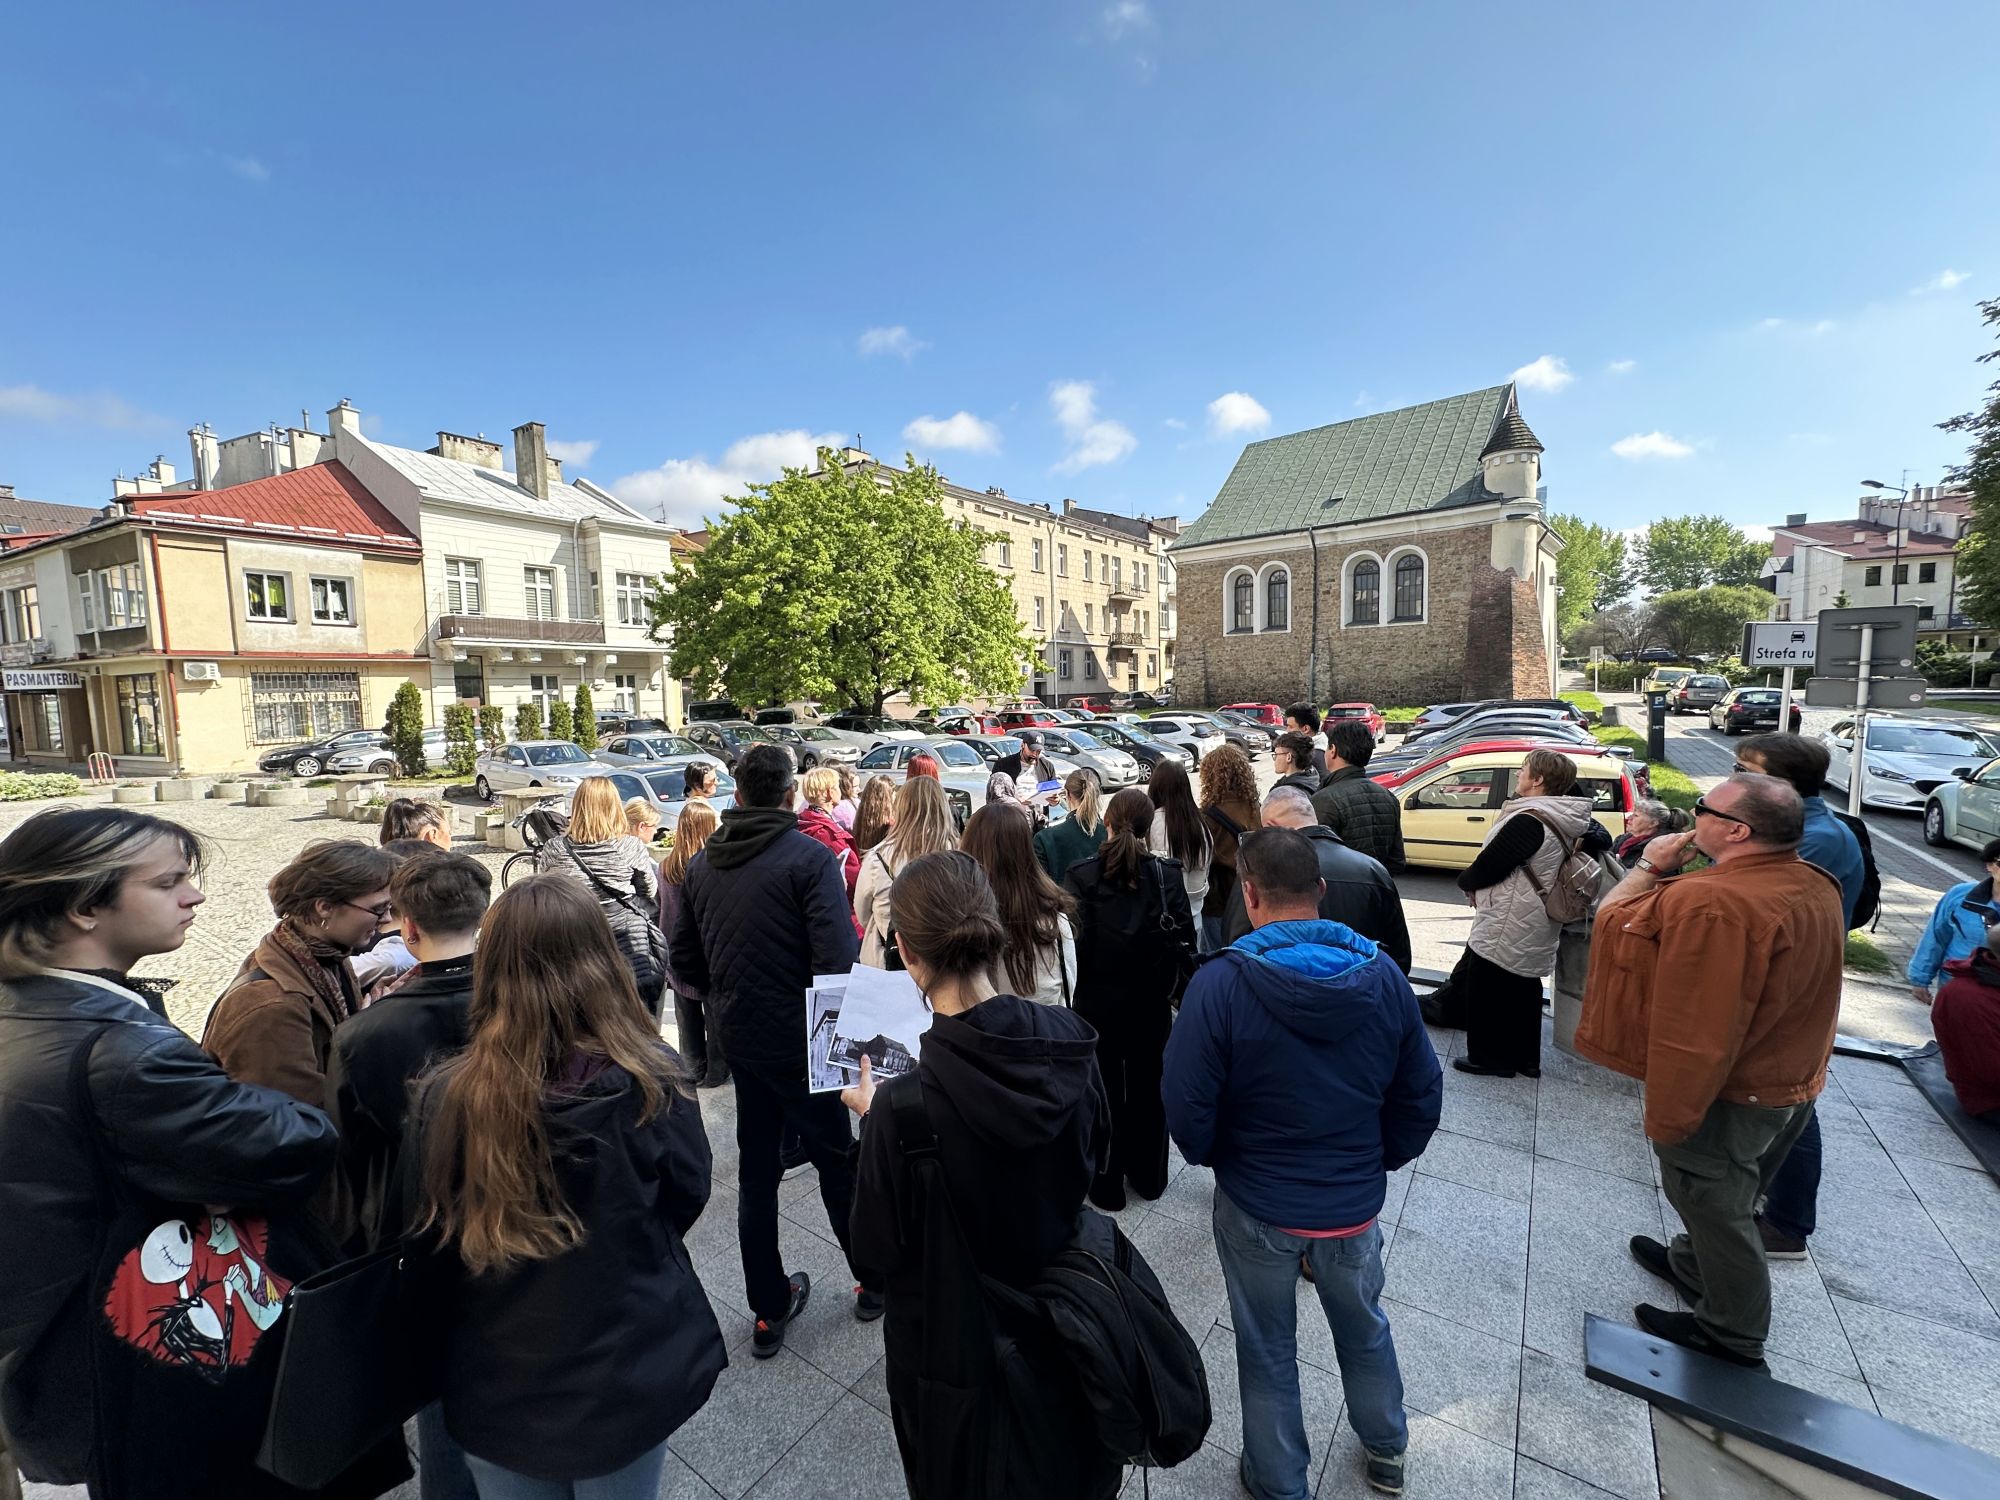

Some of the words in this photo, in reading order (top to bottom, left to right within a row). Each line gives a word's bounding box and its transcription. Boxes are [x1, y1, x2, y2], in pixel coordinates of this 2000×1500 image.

[1756, 647, 1796, 659] Strefa
[6, 672, 80, 686] PASMANTERIA
[1654, 696, 1664, 705] P
